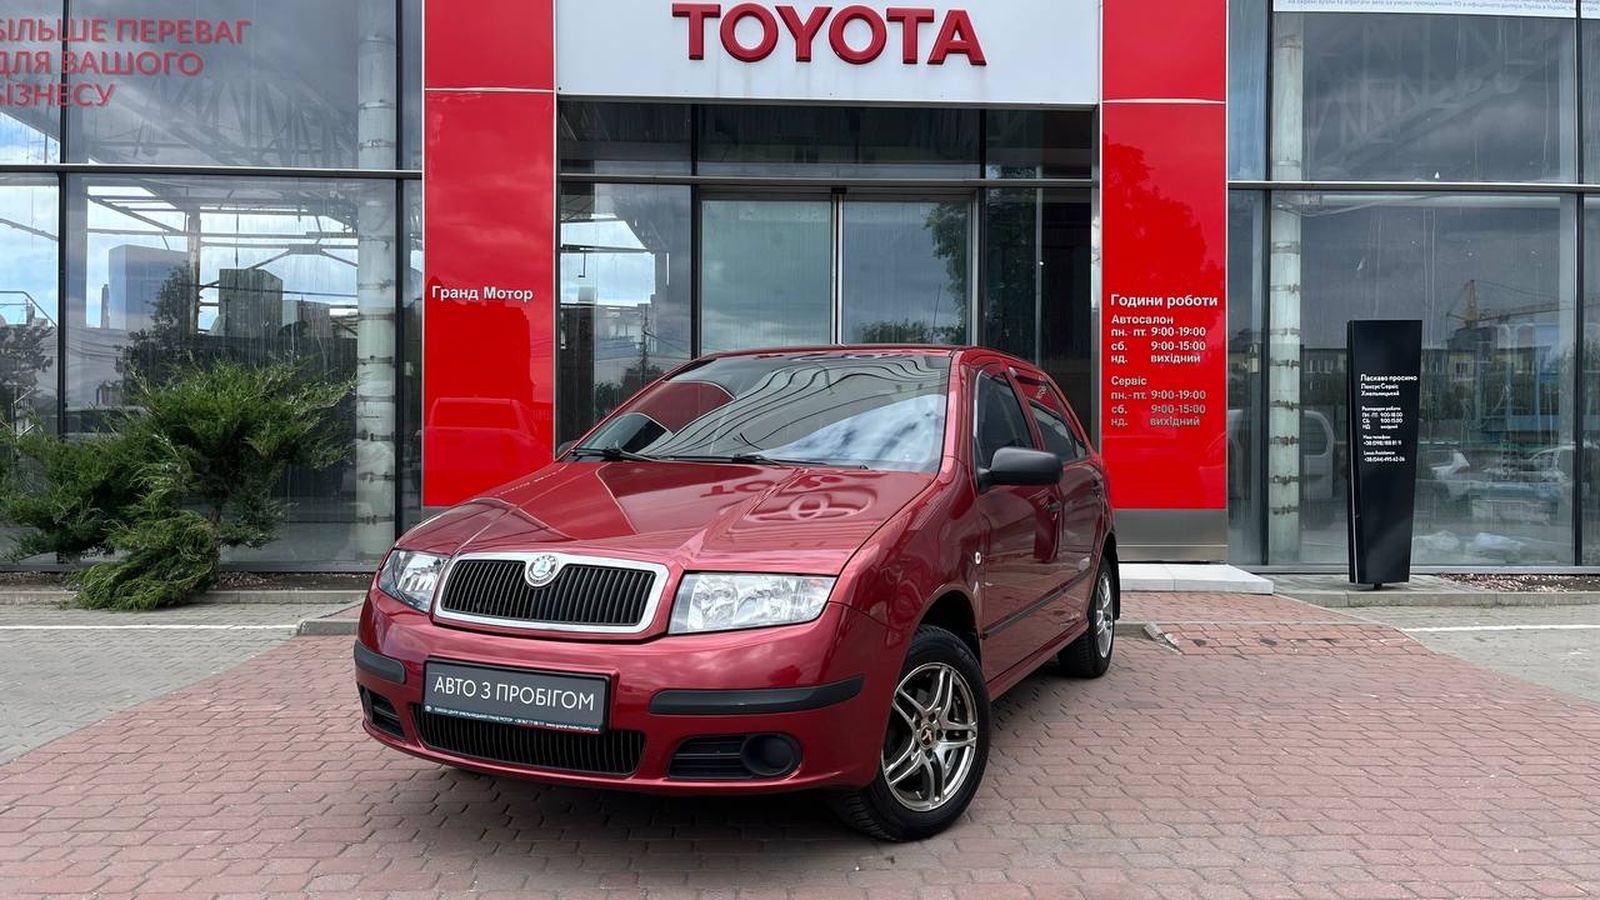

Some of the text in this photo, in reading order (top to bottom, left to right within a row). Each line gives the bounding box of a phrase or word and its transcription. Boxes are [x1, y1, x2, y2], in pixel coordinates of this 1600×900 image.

[116, 19, 252, 44] ПЕРЕВАГ
[672, 3, 988, 65] TOYOTA
[62, 51, 204, 75] ВАШОГО
[432, 285, 533, 302] Гранд Мотор
[1110, 294, 1218, 309] Години роботи
[1111, 314, 1174, 325] Автосалон
[1111, 341, 1128, 351] сб.
[1111, 353, 1200, 364] нд. вихідний
[1111, 376, 1147, 387] Сервіс
[1111, 405, 1128, 414] сб.
[1111, 416, 1200, 428] нд. вихідний
[434, 676, 477, 697] АВТО
[496, 684, 595, 711] ПРОБІГОМ
